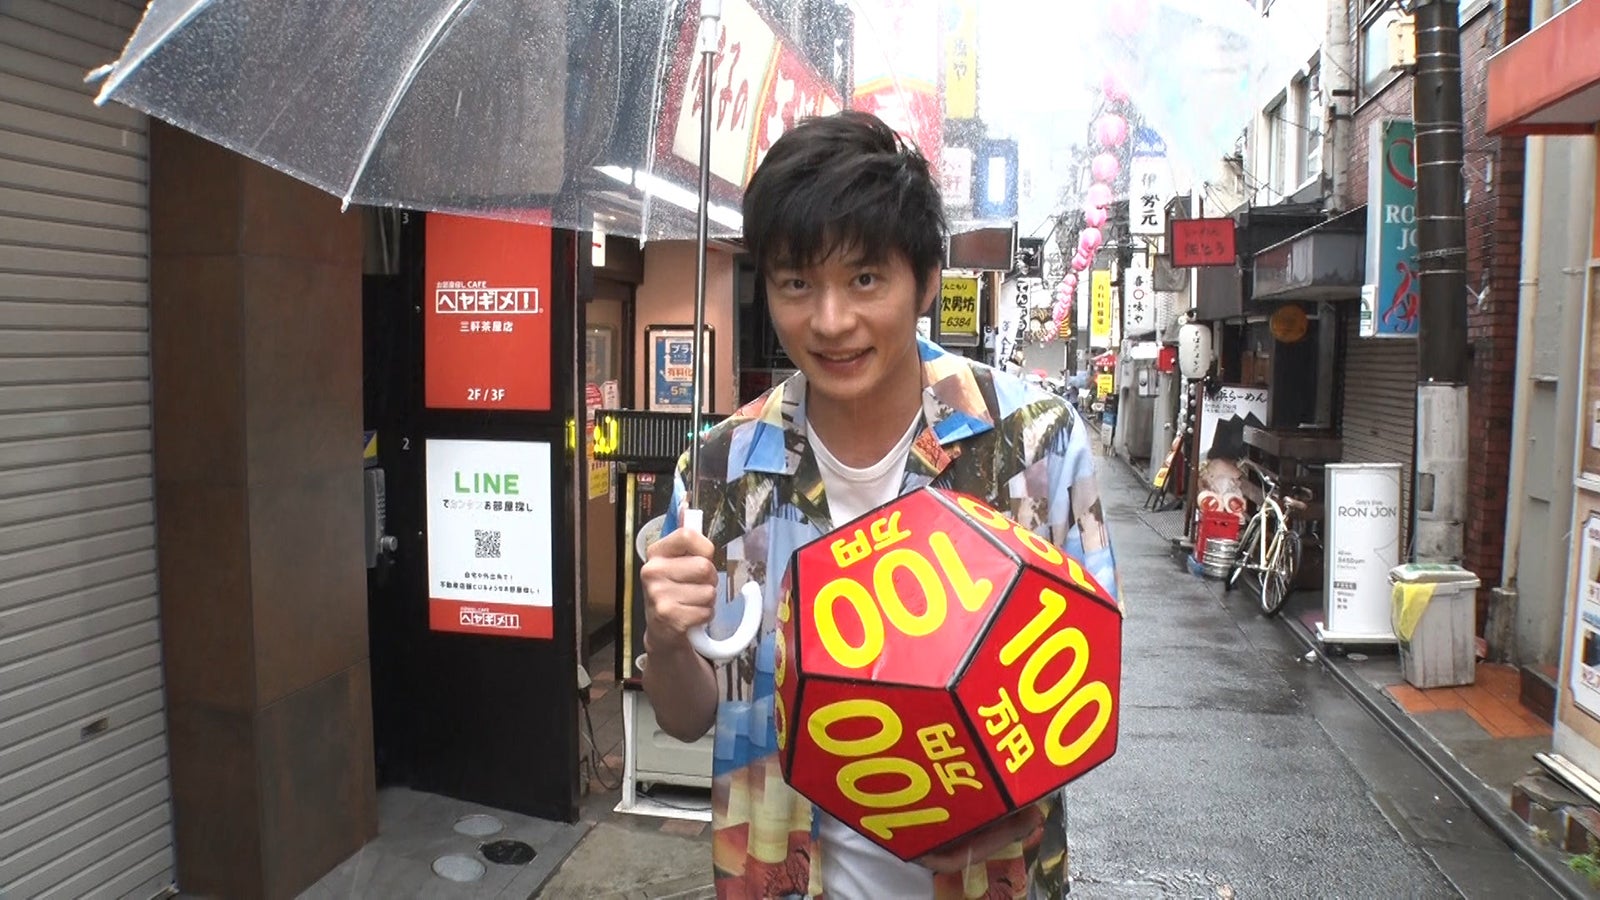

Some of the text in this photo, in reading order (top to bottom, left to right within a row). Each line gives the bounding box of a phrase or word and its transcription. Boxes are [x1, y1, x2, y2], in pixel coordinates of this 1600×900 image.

[467, 281, 488, 289] CAFE
[460, 321, 514, 333] 三軒茶屋店
[467, 388, 481, 401] 2F
[491, 389, 505, 402] 3F
[402, 437, 410, 450] 2
[454, 471, 519, 494] LINE
[1338, 506, 1398, 518] RON JON
[830, 510, 911, 568] 万円
[813, 531, 993, 669] 100
[999, 588, 1113, 766] 100
[978, 687, 1035, 774] 万円
[807, 699, 950, 840] 100
[917, 722, 984, 796] 万円
